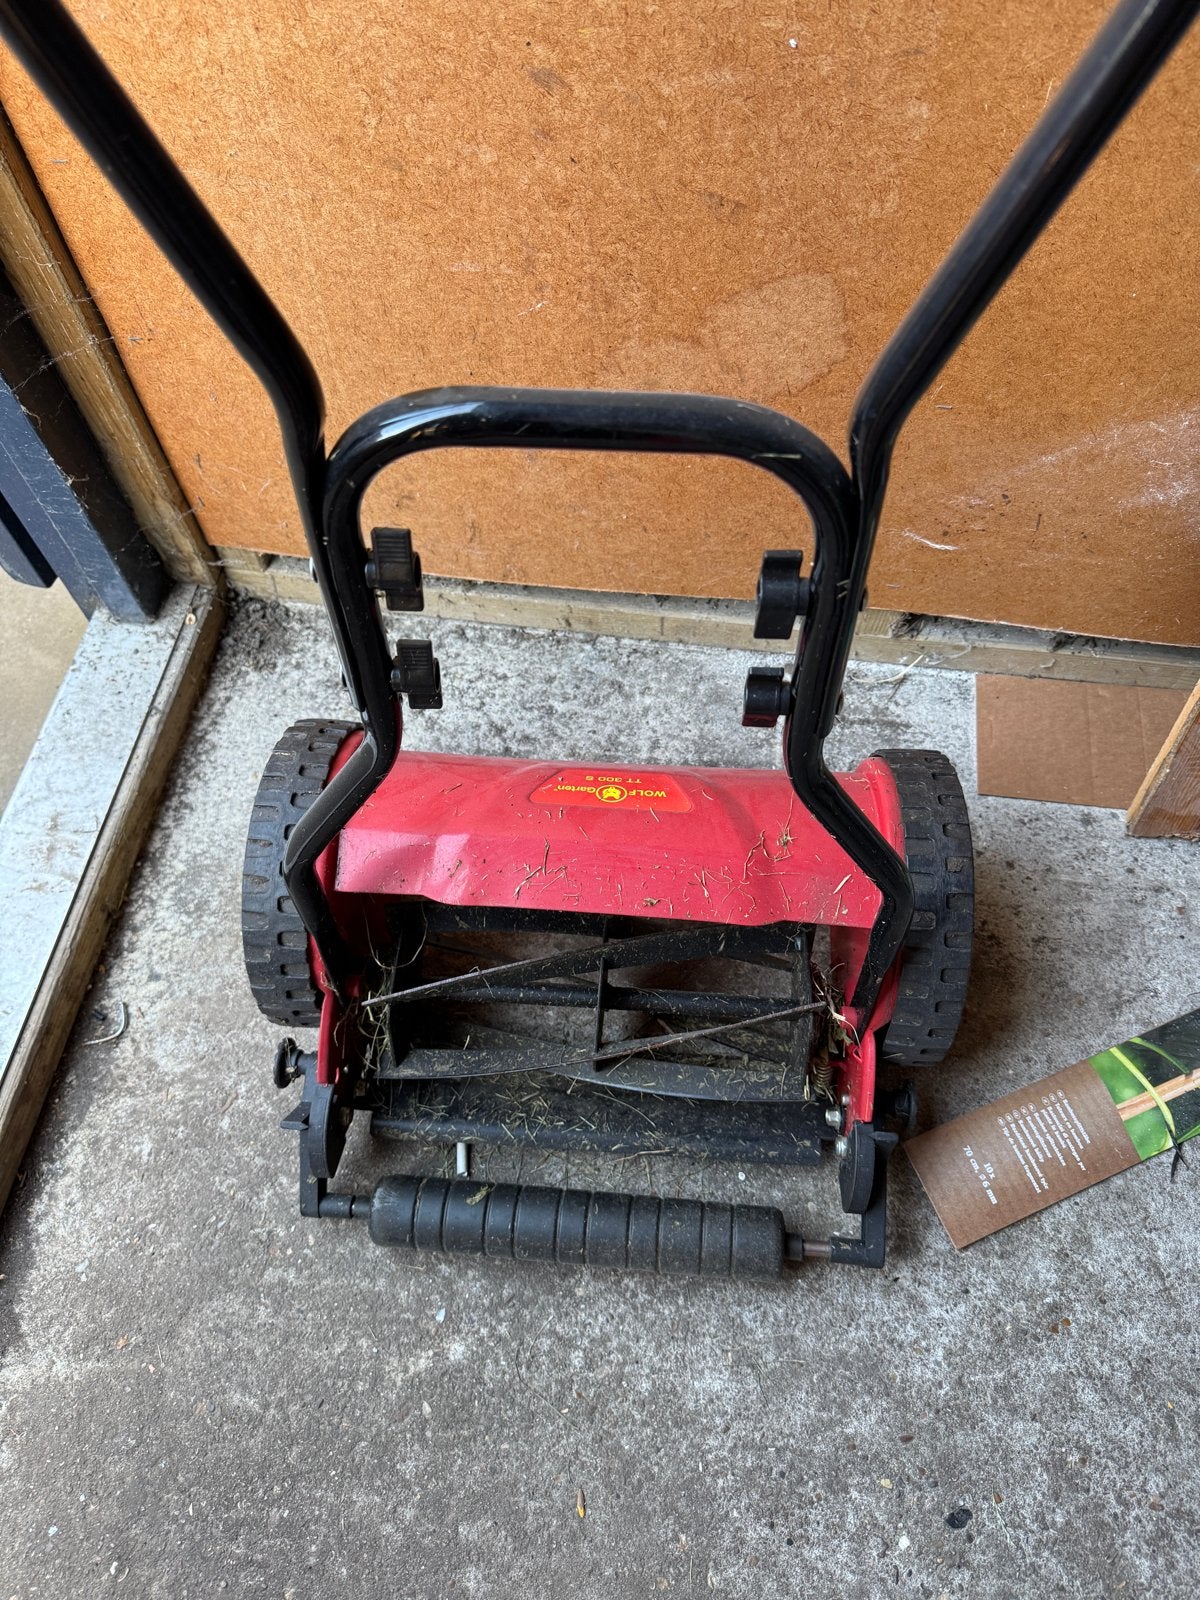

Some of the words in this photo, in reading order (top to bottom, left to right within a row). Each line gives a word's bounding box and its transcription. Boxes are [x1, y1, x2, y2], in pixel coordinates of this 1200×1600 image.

[557, 784, 597, 794] Garten
[628, 790, 667, 798] WOLF
[963, 1145, 974, 1157] 70
[969, 1158, 980, 1174] cm,
[986, 1189, 998, 1205] mm
